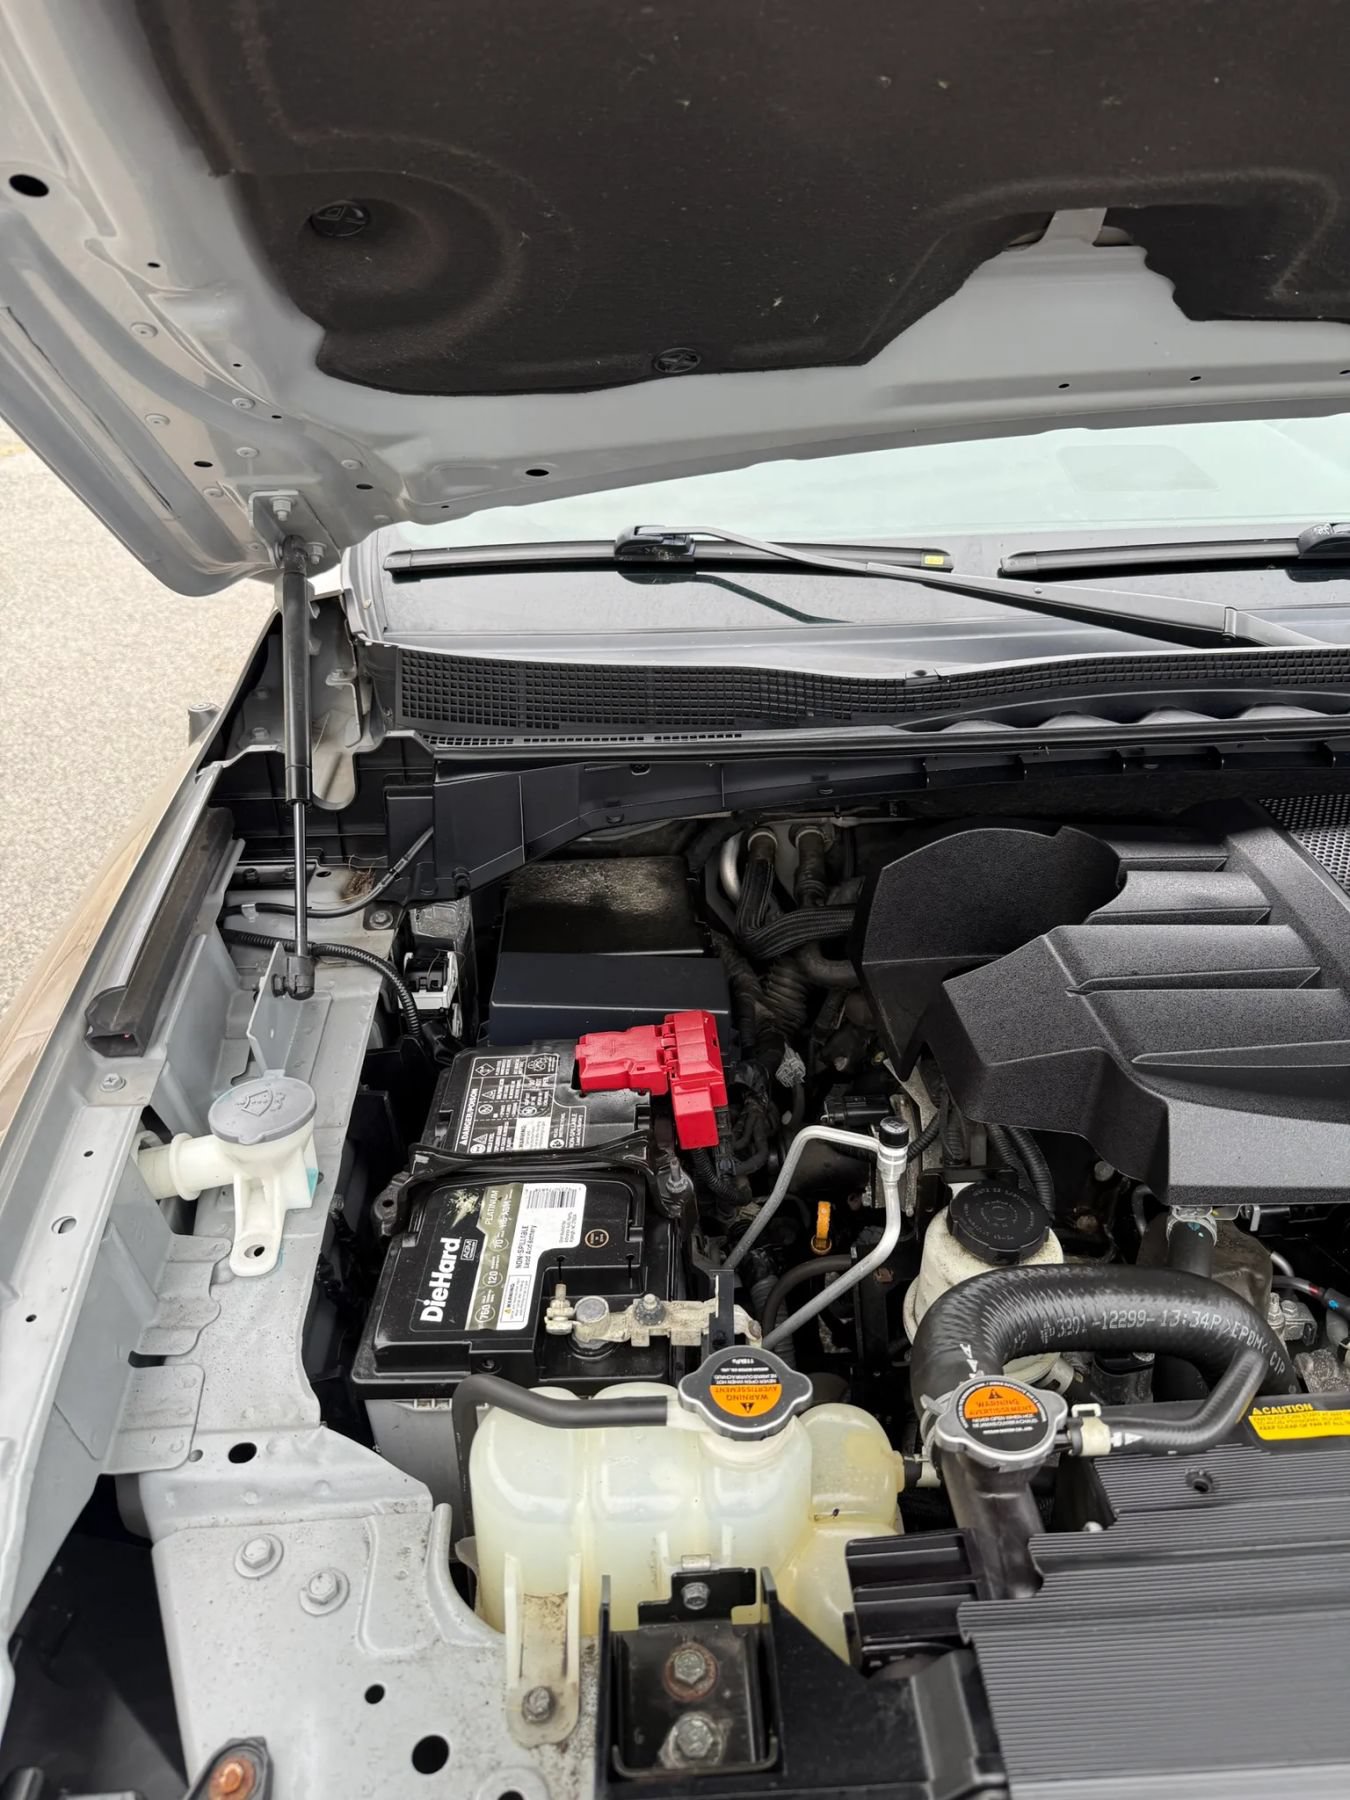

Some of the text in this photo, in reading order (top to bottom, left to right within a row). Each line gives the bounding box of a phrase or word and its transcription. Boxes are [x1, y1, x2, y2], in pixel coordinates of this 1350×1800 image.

[484, 1190, 500, 1226] PLATINUM
[528, 1225, 538, 1244] Battery
[495, 1239, 504, 1249] 70
[515, 1225, 529, 1269] NON-SPILLABLE
[420, 1237, 461, 1323] DieHard
[488, 1271, 498, 1284] 120
[480, 1304, 492, 1320] 760
[975, 1399, 1020, 1408] WARNING
[1262, 1403, 1313, 1415] CAUTION
